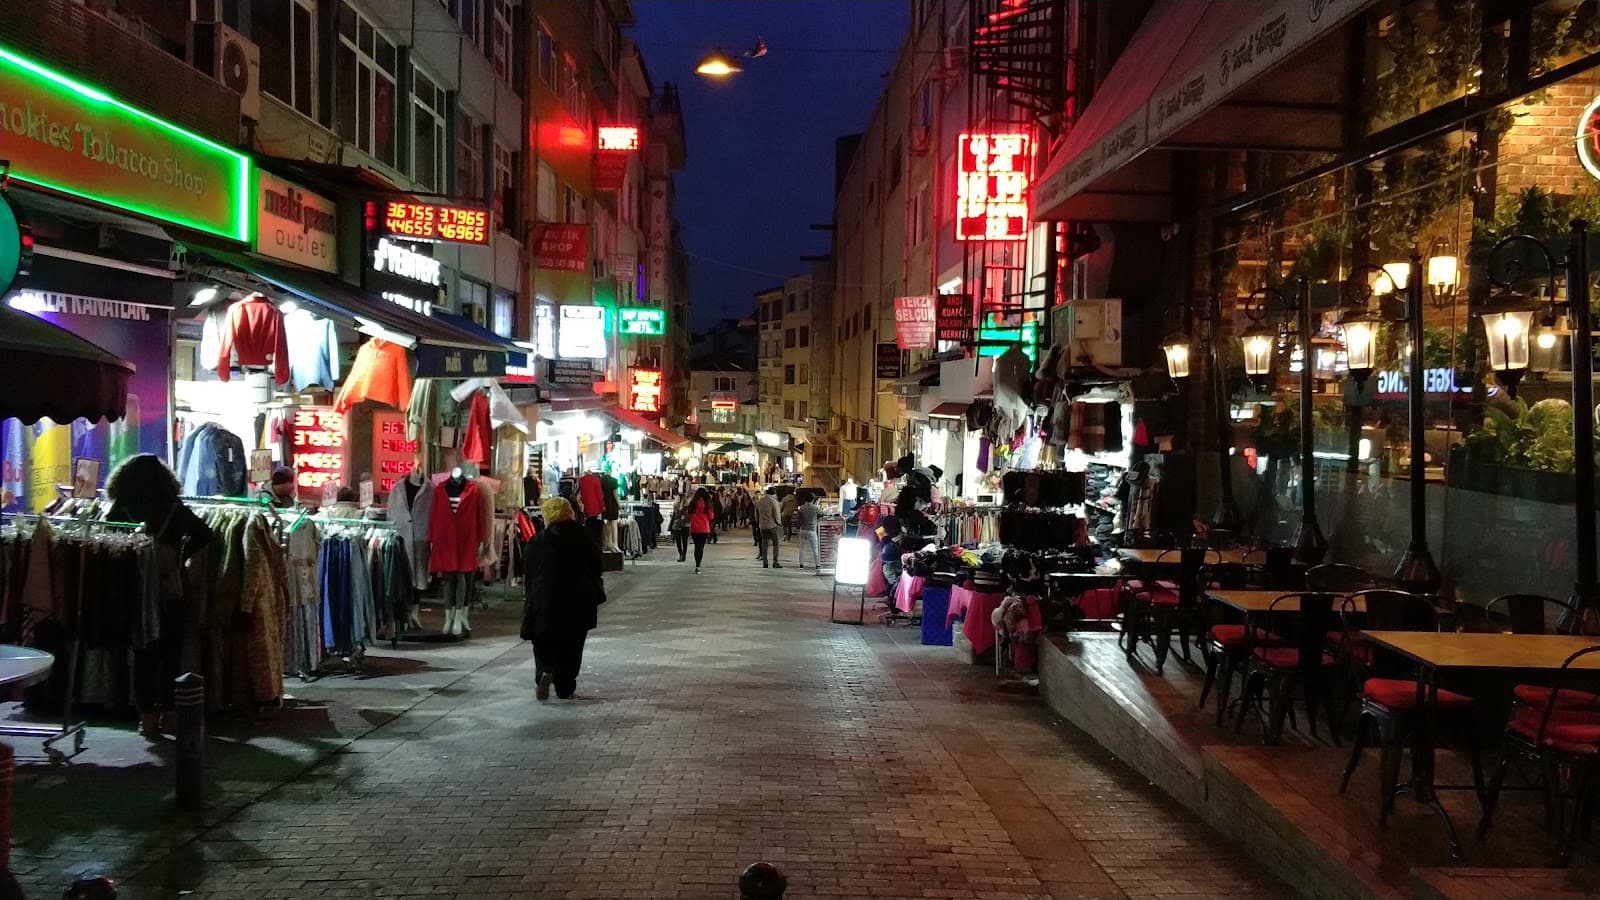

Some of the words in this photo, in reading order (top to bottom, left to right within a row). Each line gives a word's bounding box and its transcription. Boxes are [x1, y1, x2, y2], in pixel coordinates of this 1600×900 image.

[75, 122, 159, 179] Tobacco
[163, 158, 205, 199] Shop
[276, 229, 327, 258] outlet
